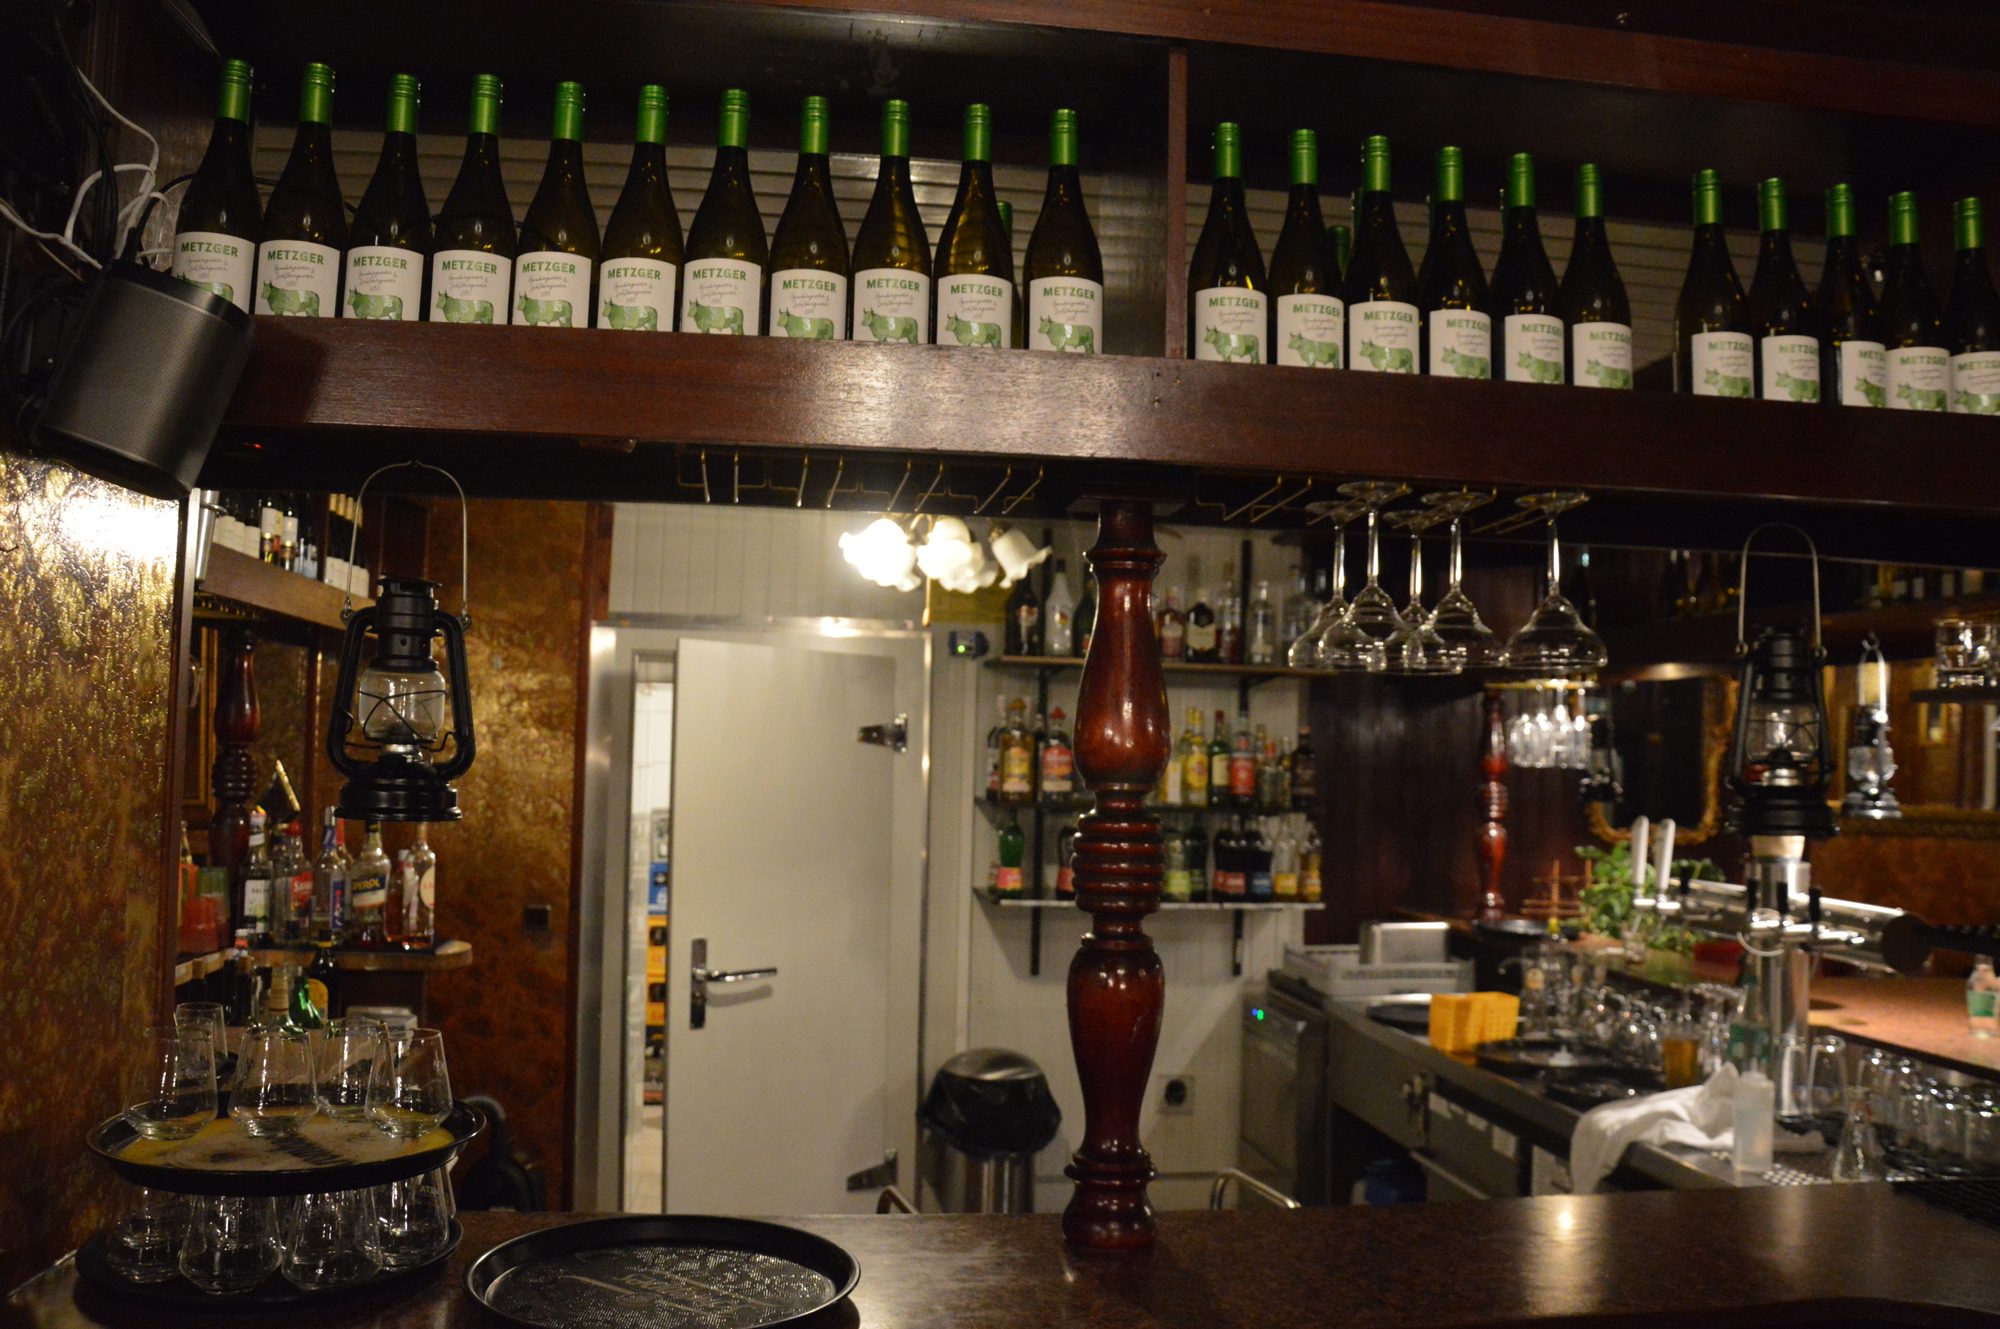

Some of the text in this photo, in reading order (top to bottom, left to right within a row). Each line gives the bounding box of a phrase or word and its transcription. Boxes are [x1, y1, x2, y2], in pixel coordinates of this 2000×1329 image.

[181, 241, 239, 258] METZGER
[267, 249, 325, 266] METZGER
[352, 255, 408, 270] METZGER
[441, 259, 498, 275] METZGER
[521, 260, 577, 275] METZGER
[607, 266, 662, 281] METZGER
[692, 267, 747, 281] METZGER
[782, 278, 837, 293] METZGER
[866, 277, 920, 292] METZGER
[950, 283, 1004, 298] METZGER
[1042, 285, 1096, 300] METZGER
[1209, 296, 1260, 310] METZGER
